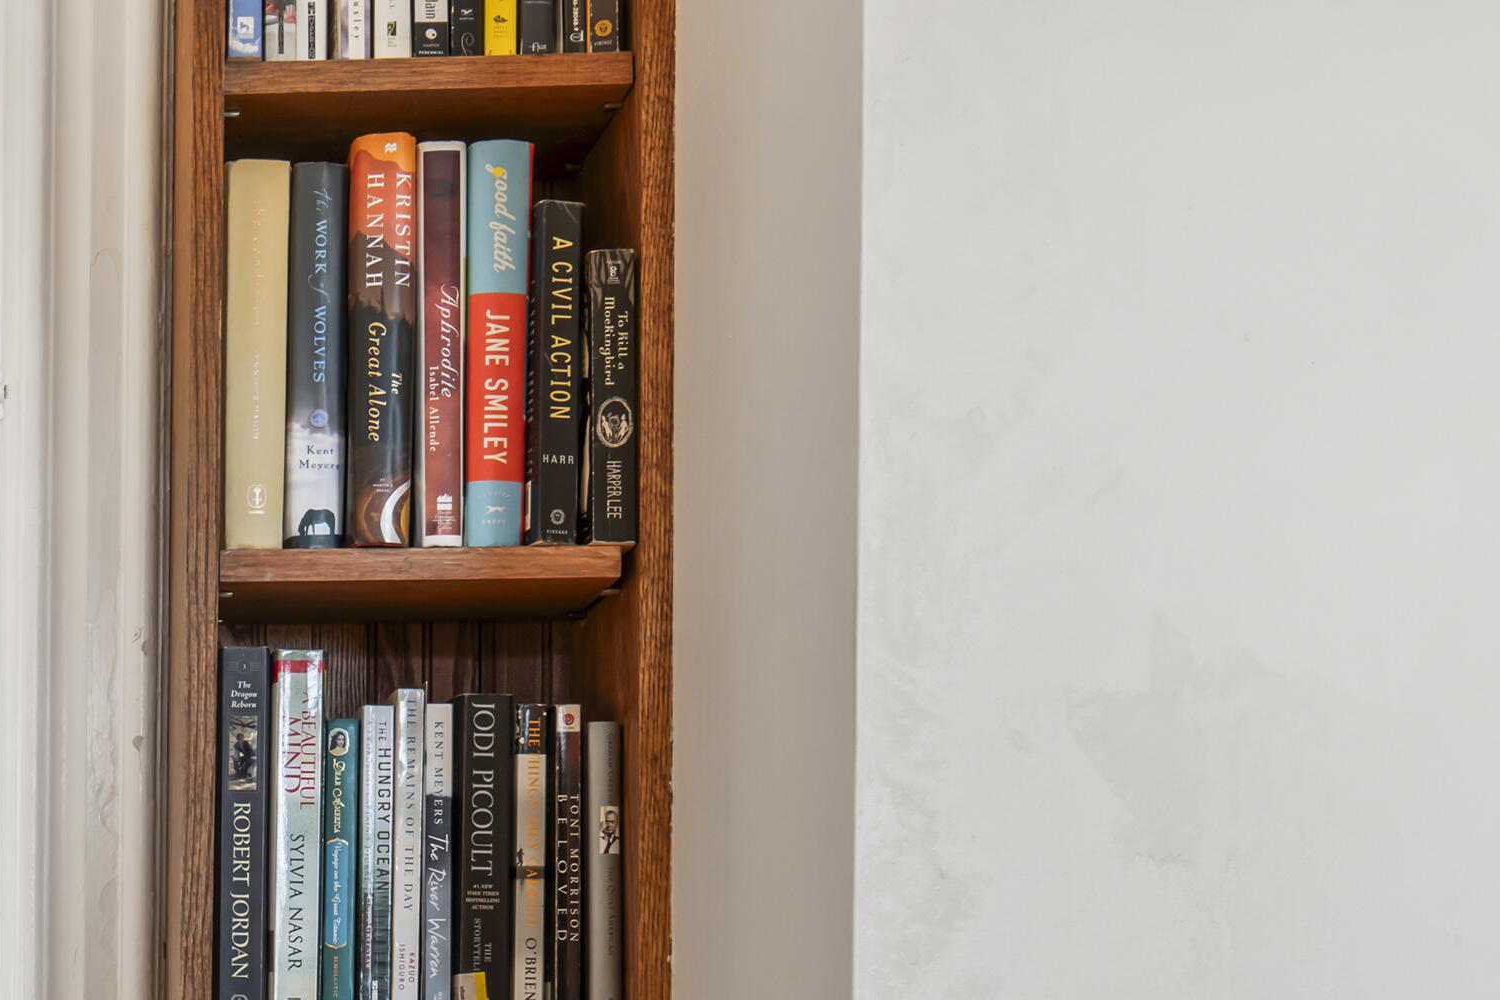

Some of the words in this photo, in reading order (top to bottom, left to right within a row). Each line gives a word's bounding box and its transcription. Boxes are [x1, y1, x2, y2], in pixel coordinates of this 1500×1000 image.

[485, 163, 516, 221] good
[365, 172, 385, 289] HANNAH
[395, 171, 411, 288] KRISTIN
[489, 221, 516, 273] faith
[553, 236, 574, 251] A
[551, 261, 573, 326] CIVIL
[368, 321, 387, 378] Great
[434, 283, 460, 398] Aphrodite
[484, 307, 510, 367] JANE
[599, 296, 617, 386] Mockingbird
[390, 372, 403, 396] The
[428, 365, 440, 401] Isabel
[550, 335, 573, 420] ACTION
[368, 384, 387, 442] Alone
[428, 406, 440, 453] Allende
[482, 378, 509, 465] SMILEY
[307, 445, 334, 455] Kent
[542, 454, 575, 465] HARR
[606, 459, 623, 498] HARPER
[606, 498, 623, 520] LEE
[231, 691, 257, 699] Dragon
[231, 700, 257, 709] Reborn
[238, 681, 251, 690] The
[378, 721, 388, 743] THE
[407, 697, 418, 729] THE
[471, 702, 496, 759] JODI
[528, 717, 541, 748] THE
[282, 715, 303, 794] MIND
[434, 721, 444, 761] KENT
[377, 748, 392, 824] HUNGRY
[405, 737, 418, 810] REMAINS
[433, 767, 444, 825] MEYERS
[526, 749, 541, 808] THINGS
[405, 817, 417, 838] OF
[470, 769, 495, 877] PICOULT
[525, 810, 540, 850] THEY
[570, 793, 580, 838] TONI
[231, 802, 251, 887] ROBERT
[289, 833, 306, 900] SYLVIA
[375, 831, 391, 891] OCEAN
[404, 845, 415, 876] THE
[428, 834, 450, 862] The
[403, 884, 414, 912] DAY
[428, 867, 447, 912] River
[524, 855, 540, 926] CARRIED
[569, 848, 580, 942] MORRISON
[230, 891, 250, 980] JORDAN
[288, 907, 304, 972] NASAR
[427, 918, 447, 979] Warren
[484, 942, 493, 964] THE
[398, 944, 407, 991] ISHIGURO
[408, 952, 417, 984] KAZUO
